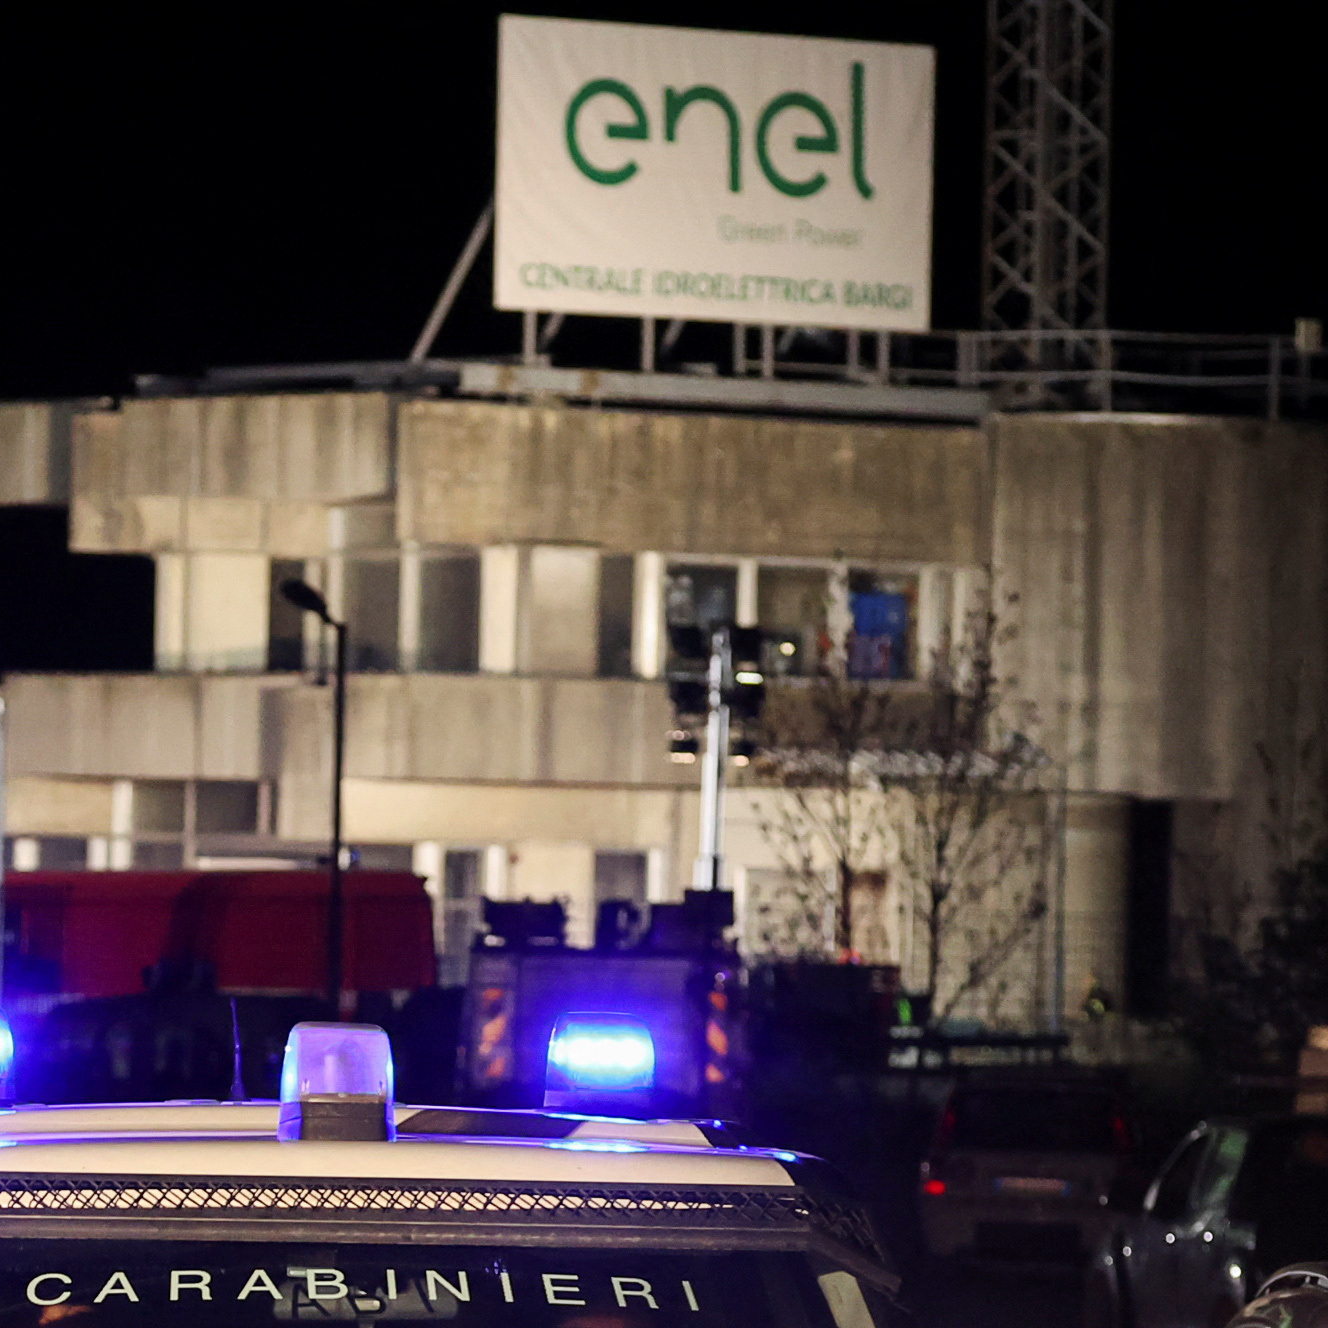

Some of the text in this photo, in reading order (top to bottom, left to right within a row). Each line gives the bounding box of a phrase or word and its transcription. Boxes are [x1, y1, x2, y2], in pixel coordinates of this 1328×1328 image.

[565, 61, 874, 200] enel
[519, 262, 913, 309] CENTRALE IDROELETTRICA BARGI
[26, 1267, 700, 1312] CARABINIERI
